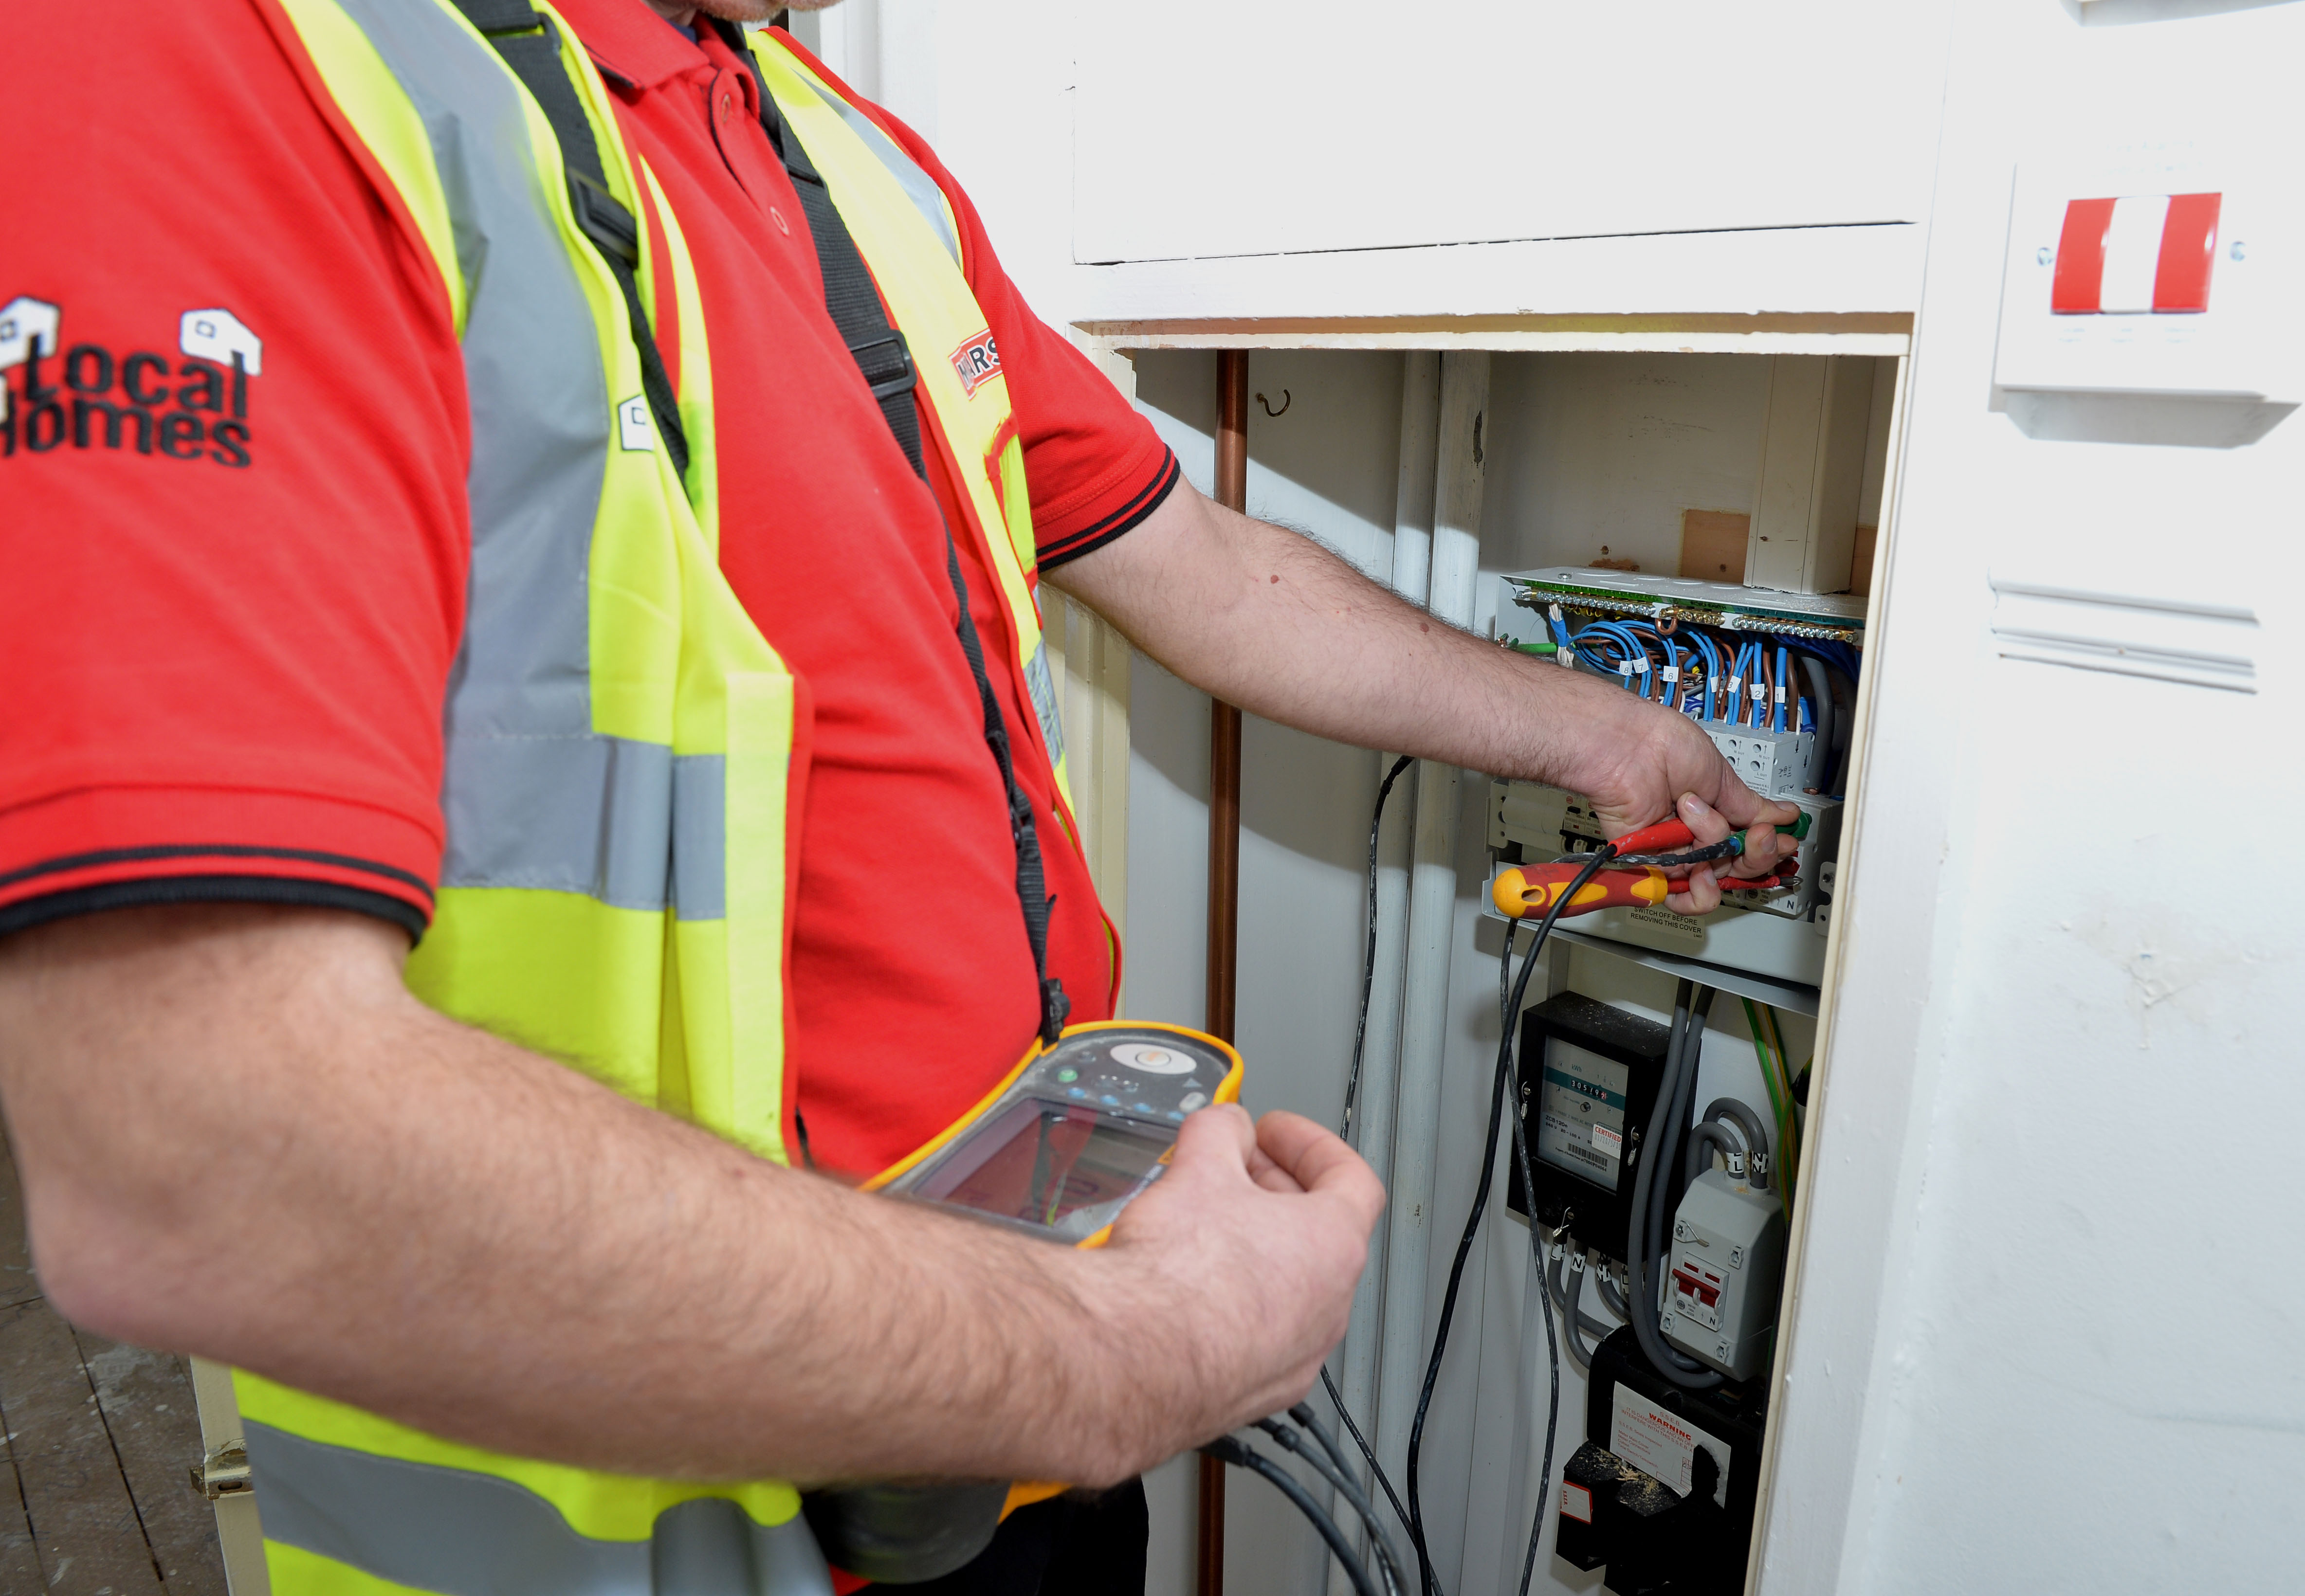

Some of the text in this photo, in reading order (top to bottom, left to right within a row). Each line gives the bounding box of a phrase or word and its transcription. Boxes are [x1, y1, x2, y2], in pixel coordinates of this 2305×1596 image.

[25, 334, 247, 418] Local
[1787, 900, 1794, 909] N
[1631, 913, 1663, 925] REMOVING
[1680, 924, 1701, 933] COVER
[1634, 907, 1657, 916] SWITCH
[1672, 915, 1697, 925] BEFORE
[1572, 1064, 1582, 1072] kWh
[1595, 1126, 1621, 1142] CERTIFIED
[1735, 1161, 1742, 1171] L
[1573, 1257, 1582, 1268] N
[1709, 1317, 1715, 1325] N
[1621, 1410, 1647, 1426] INTERFERE
[1647, 1424, 1659, 1433] WITH
[1660, 1432, 1670, 1440] THIS
[1636, 1413, 1665, 1432] DANGEROUS
[1649, 1413, 1691, 1441] WARNING
[1660, 1412, 1681, 1427] S.S.E.B.
[1629, 1440, 1650, 1455] Connections
[1645, 1434, 1662, 1448] Inspected
